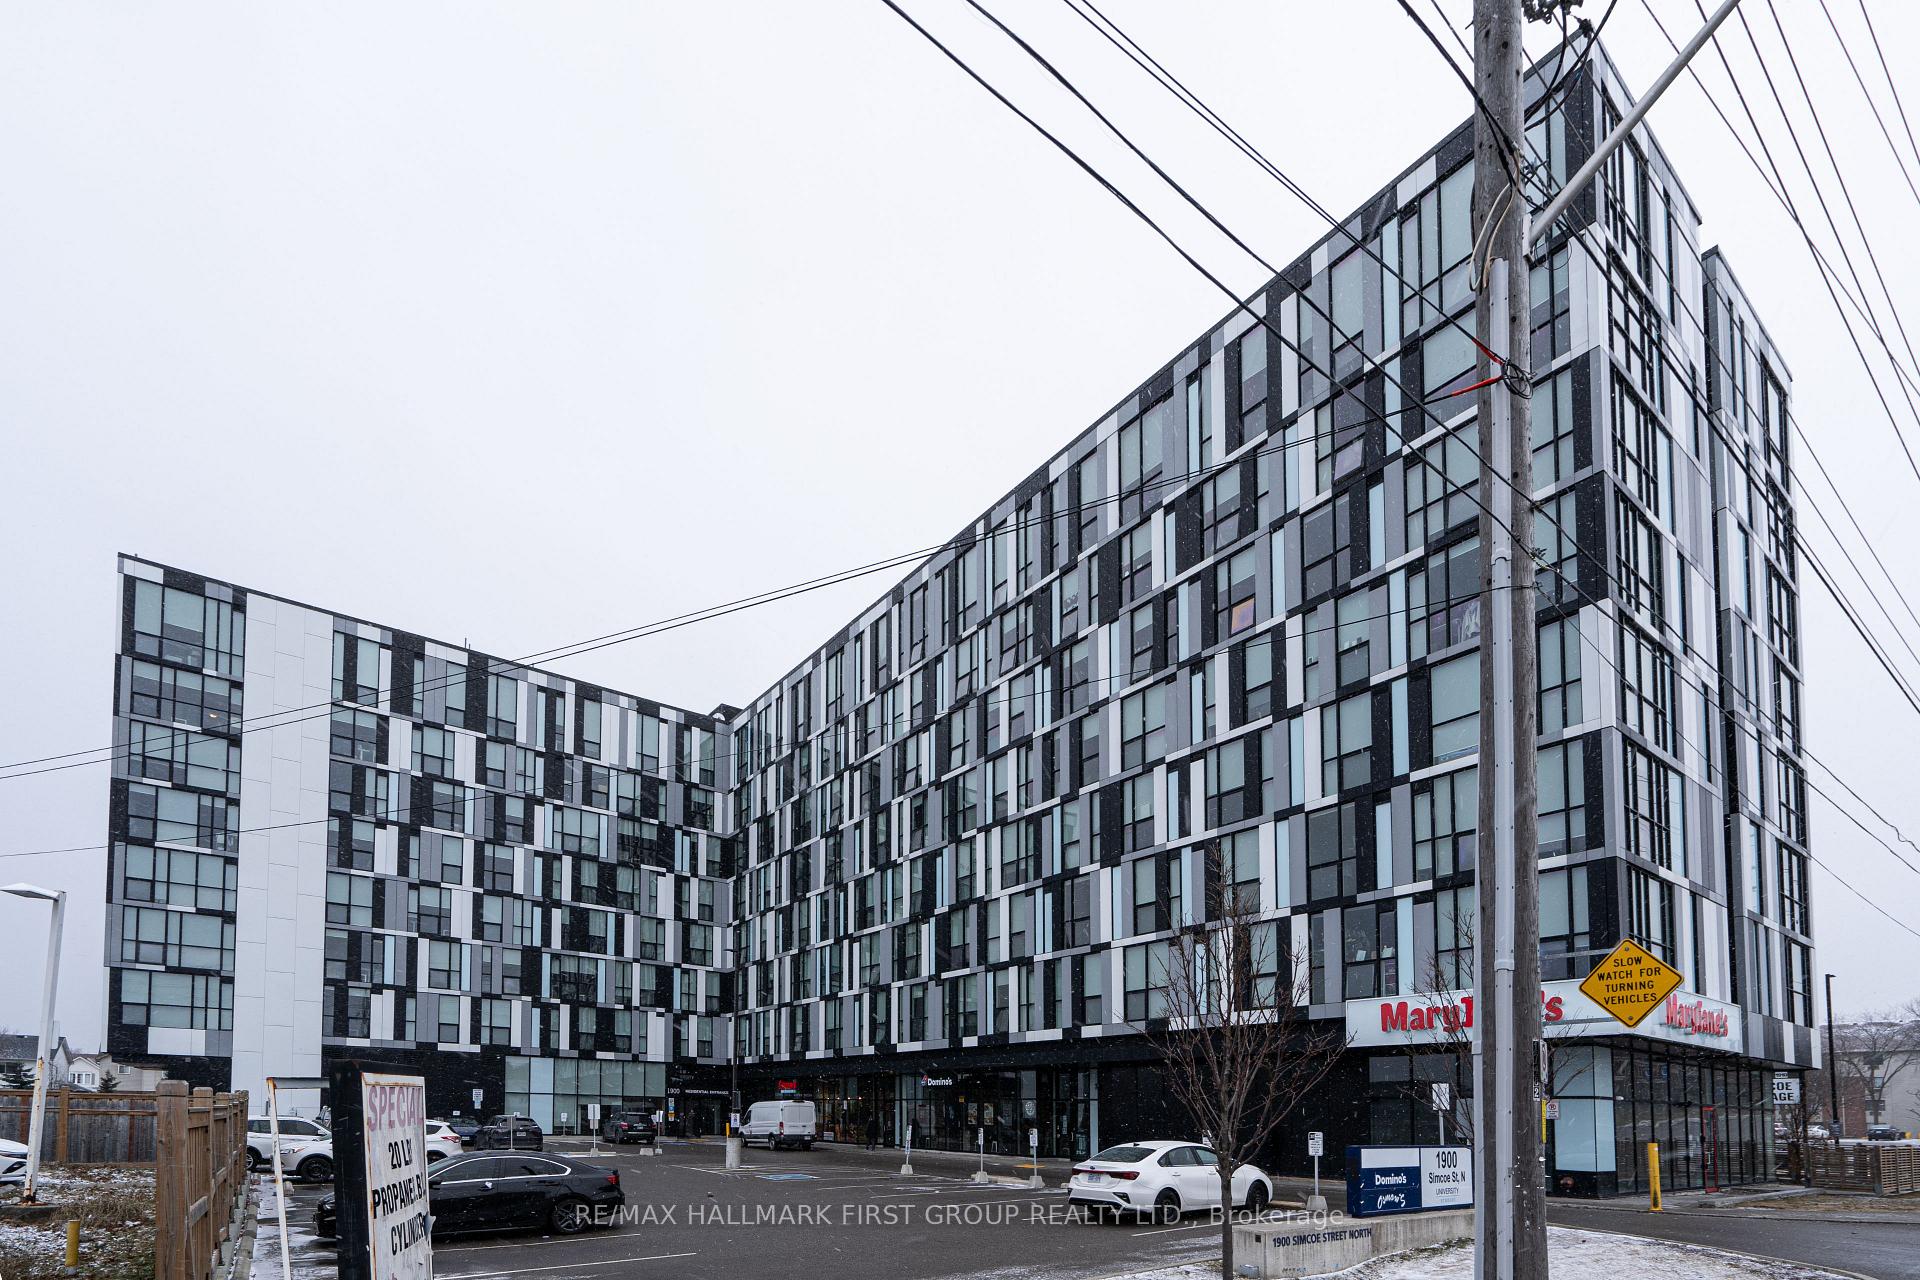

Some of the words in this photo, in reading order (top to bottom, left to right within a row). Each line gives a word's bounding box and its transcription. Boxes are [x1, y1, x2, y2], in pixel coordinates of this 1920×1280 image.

[1613, 956, 1643, 968] SLOW
[1597, 969, 1633, 982] WATCH
[1639, 966, 1661, 978] FOR
[1605, 980, 1655, 993] TURNING
[1603, 992, 1657, 1005] VEHICLES
[1665, 993, 1729, 1038] MaryJane's
[928, 1077, 952, 1086] Domino's
[367, 1085, 424, 1132] SPECIAL
[388, 1141, 402, 1170] 20
[1435, 1150, 1458, 1169] 1900
[1375, 1172, 1407, 1185] Domino's
[1429, 1172, 1451, 1184] Simcoe
[1460, 1171, 1466, 1182] N
[1435, 1187, 1460, 1196] UNIVERSITY
[1272, 1236, 1291, 1248] 1900
[1292, 1233, 1322, 1246] SIMCOE
[1322, 1230, 1348, 1242] STREET
[1348, 1228, 1372, 1240] NORTH
